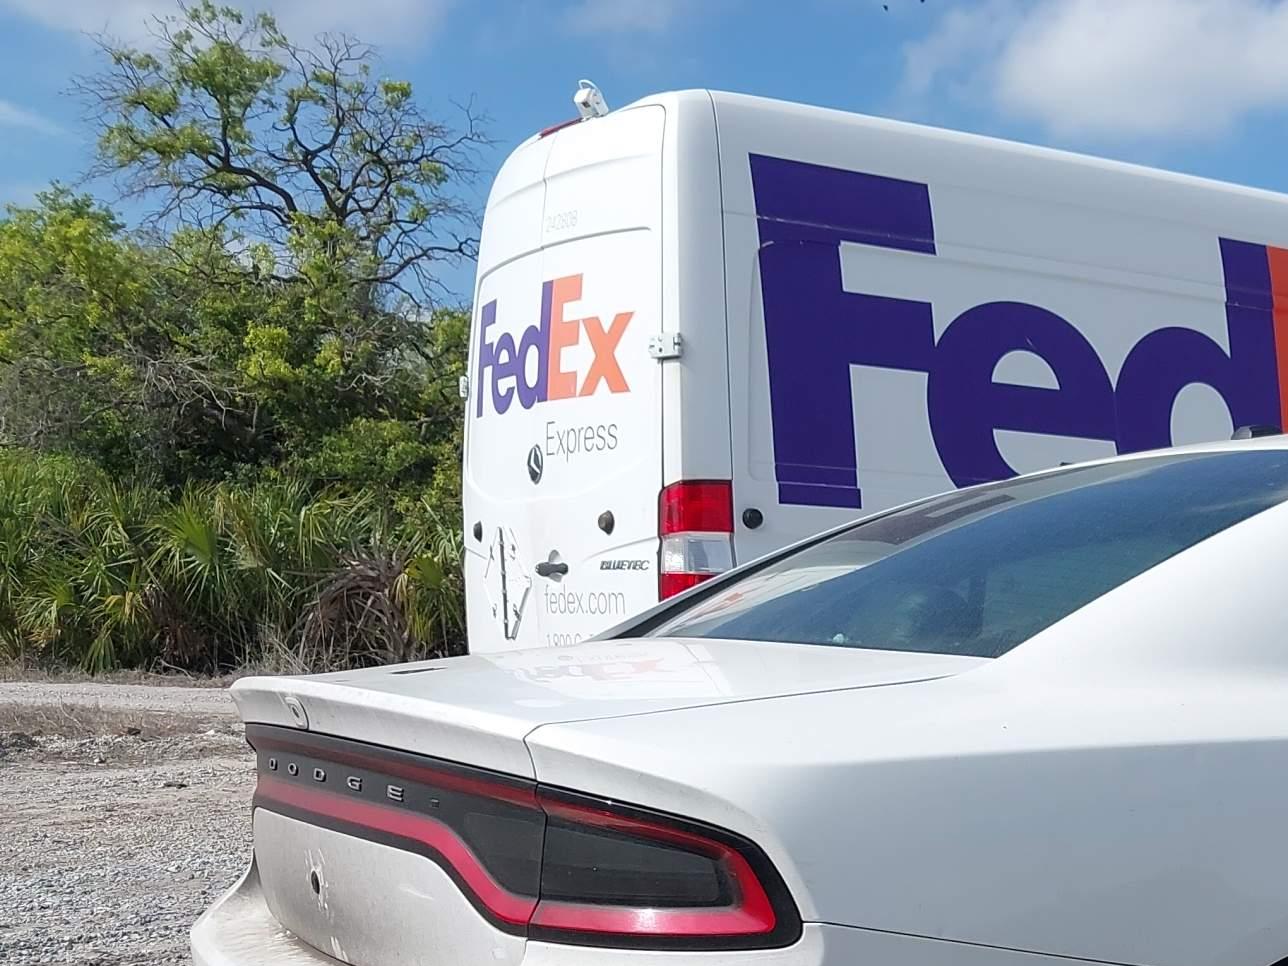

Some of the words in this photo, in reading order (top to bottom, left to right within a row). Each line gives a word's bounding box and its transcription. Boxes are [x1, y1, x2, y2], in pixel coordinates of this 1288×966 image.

[477, 273, 635, 418] FedEx
[546, 421, 618, 462] Express
[544, 583, 626, 615] fedex.com
[268, 758, 404, 802] DODGE
